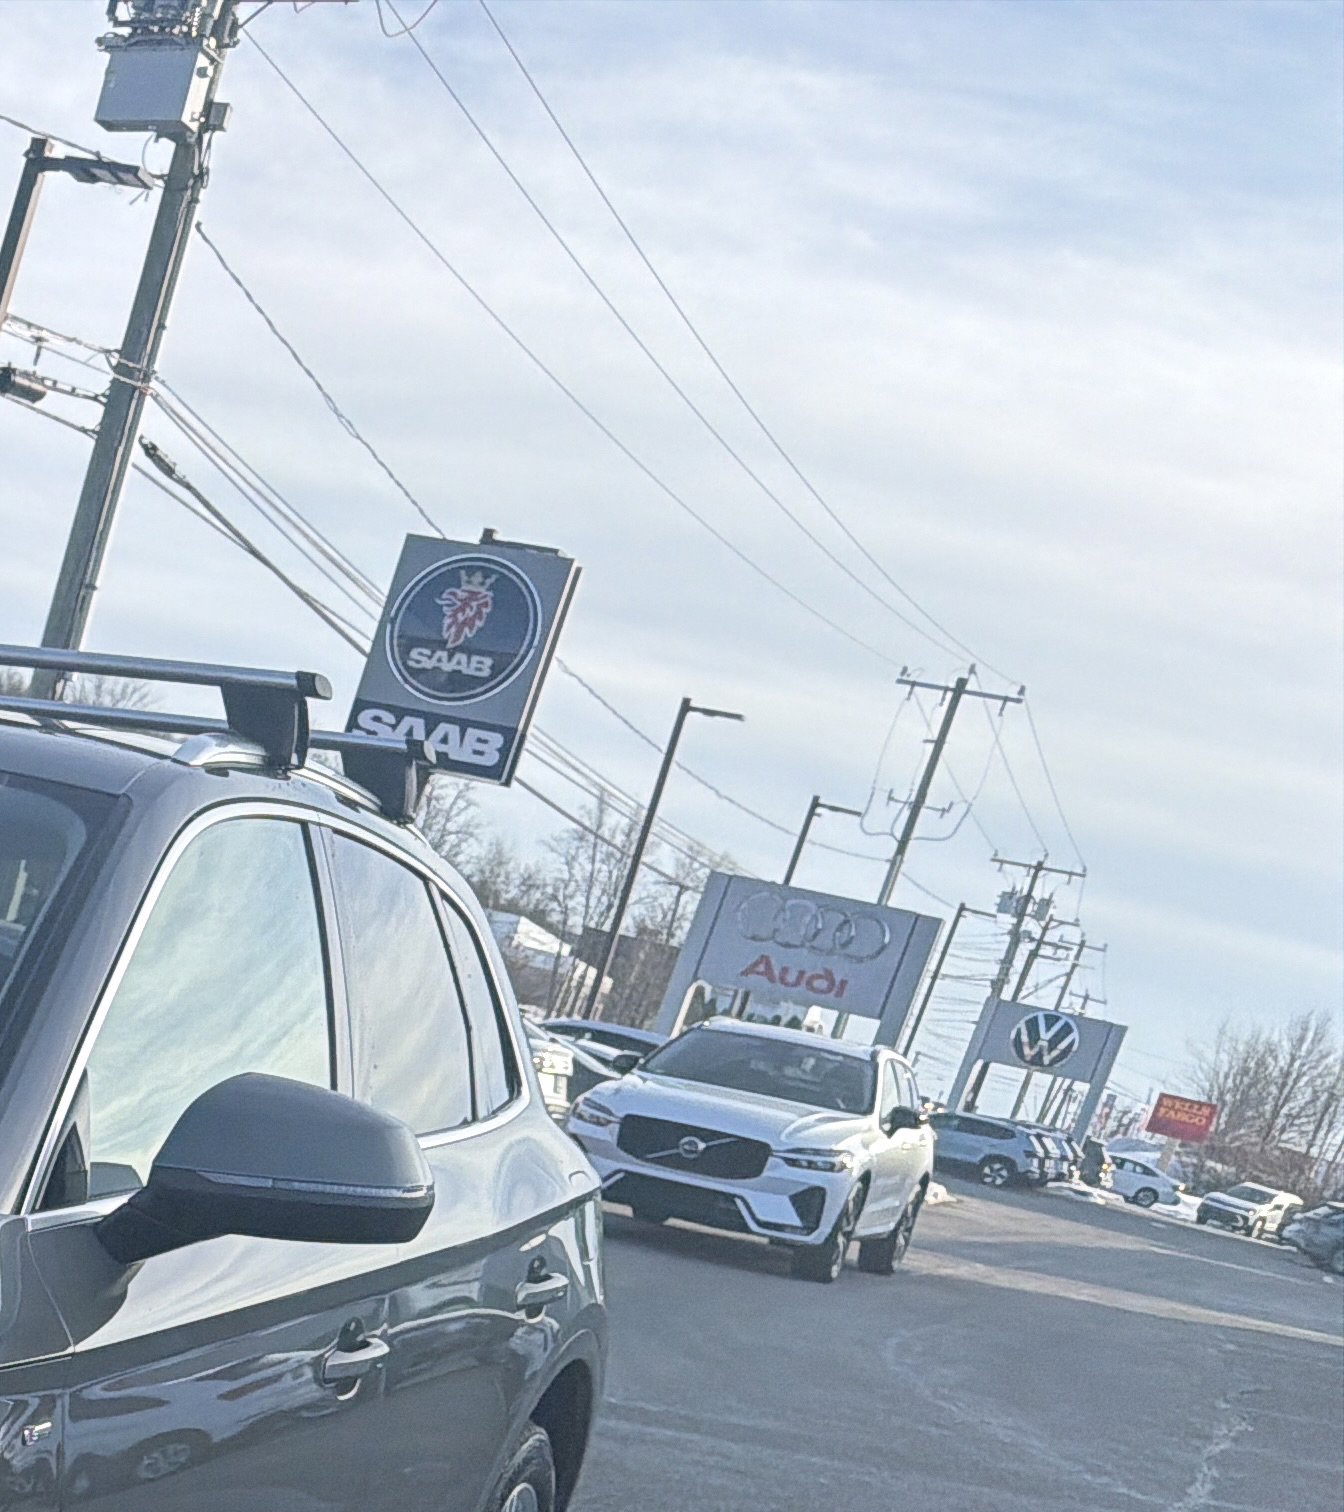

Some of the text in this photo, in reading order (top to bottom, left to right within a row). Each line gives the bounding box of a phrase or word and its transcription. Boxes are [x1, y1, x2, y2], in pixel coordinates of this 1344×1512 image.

[406, 647, 495, 678] SAAB
[352, 708, 505, 767] SAAB
[738, 954, 849, 998] Audi
